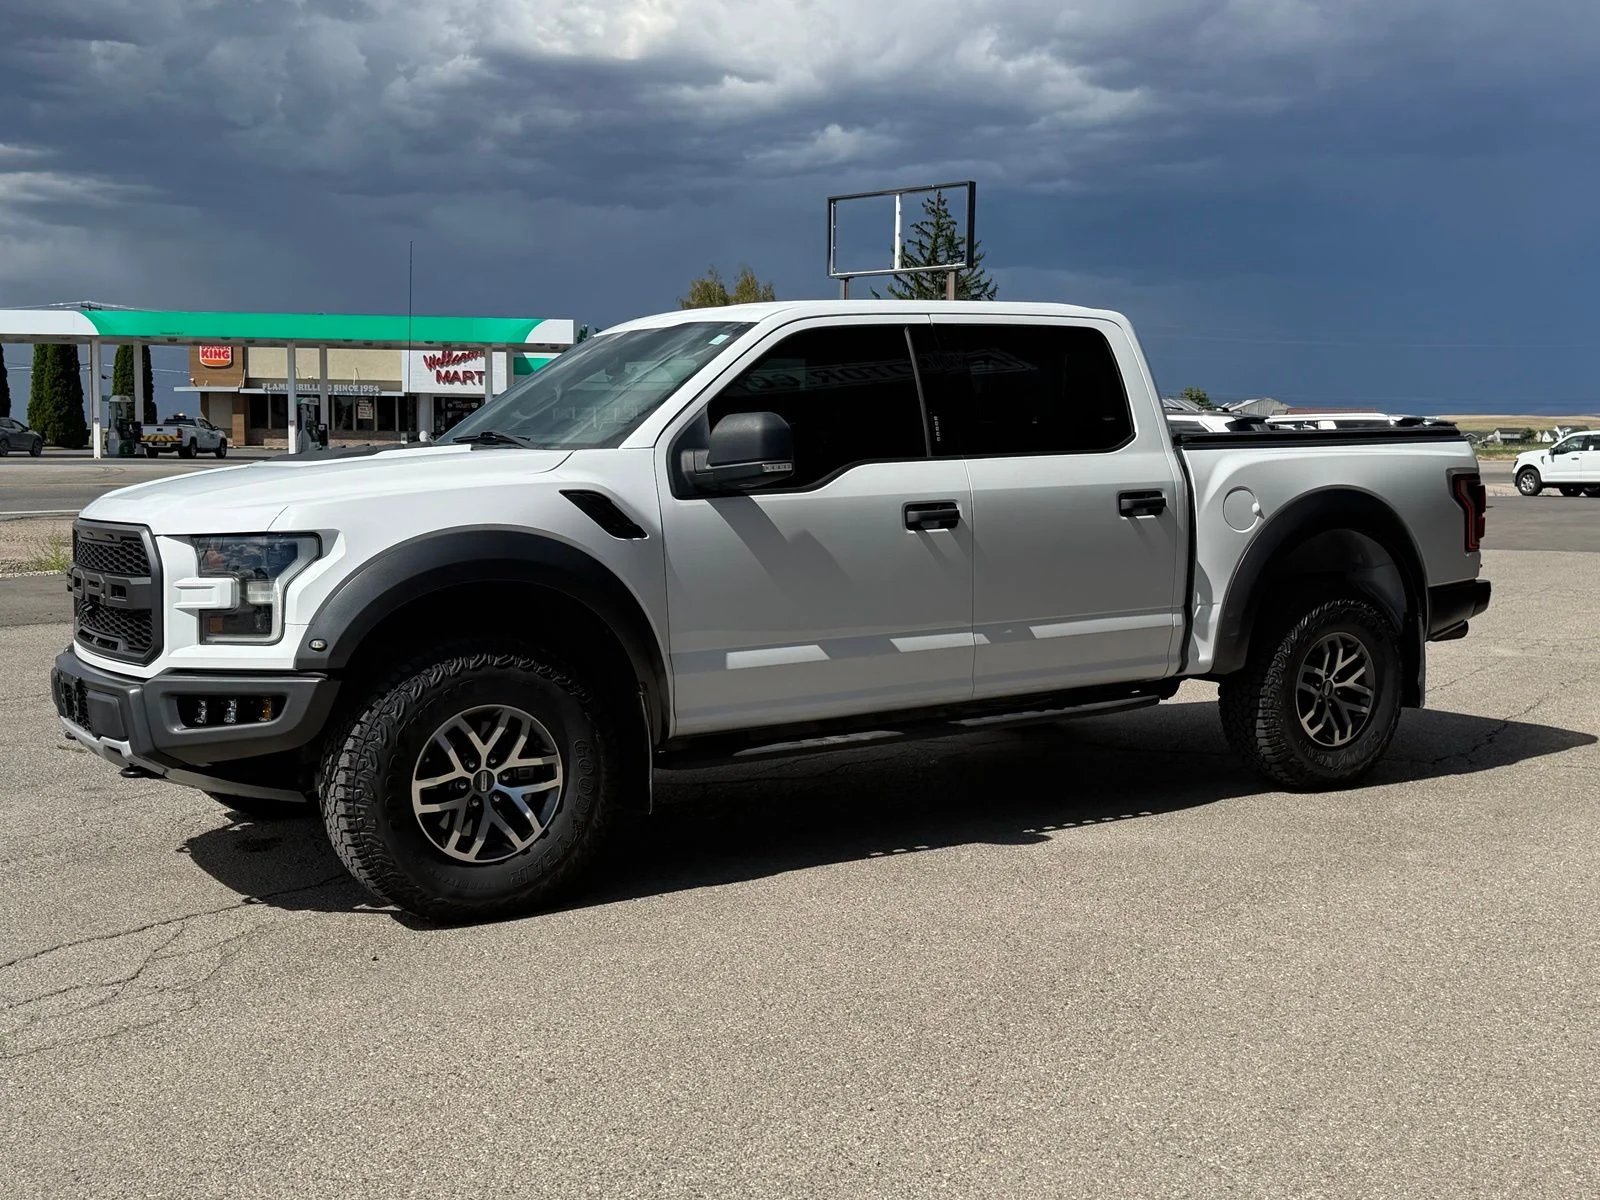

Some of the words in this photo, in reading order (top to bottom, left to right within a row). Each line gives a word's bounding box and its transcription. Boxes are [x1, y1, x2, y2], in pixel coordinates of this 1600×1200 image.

[201, 350, 230, 359] KING
[435, 370, 486, 385] MART
[333, 384, 359, 392] SINCE
[360, 384, 380, 392] 1954
